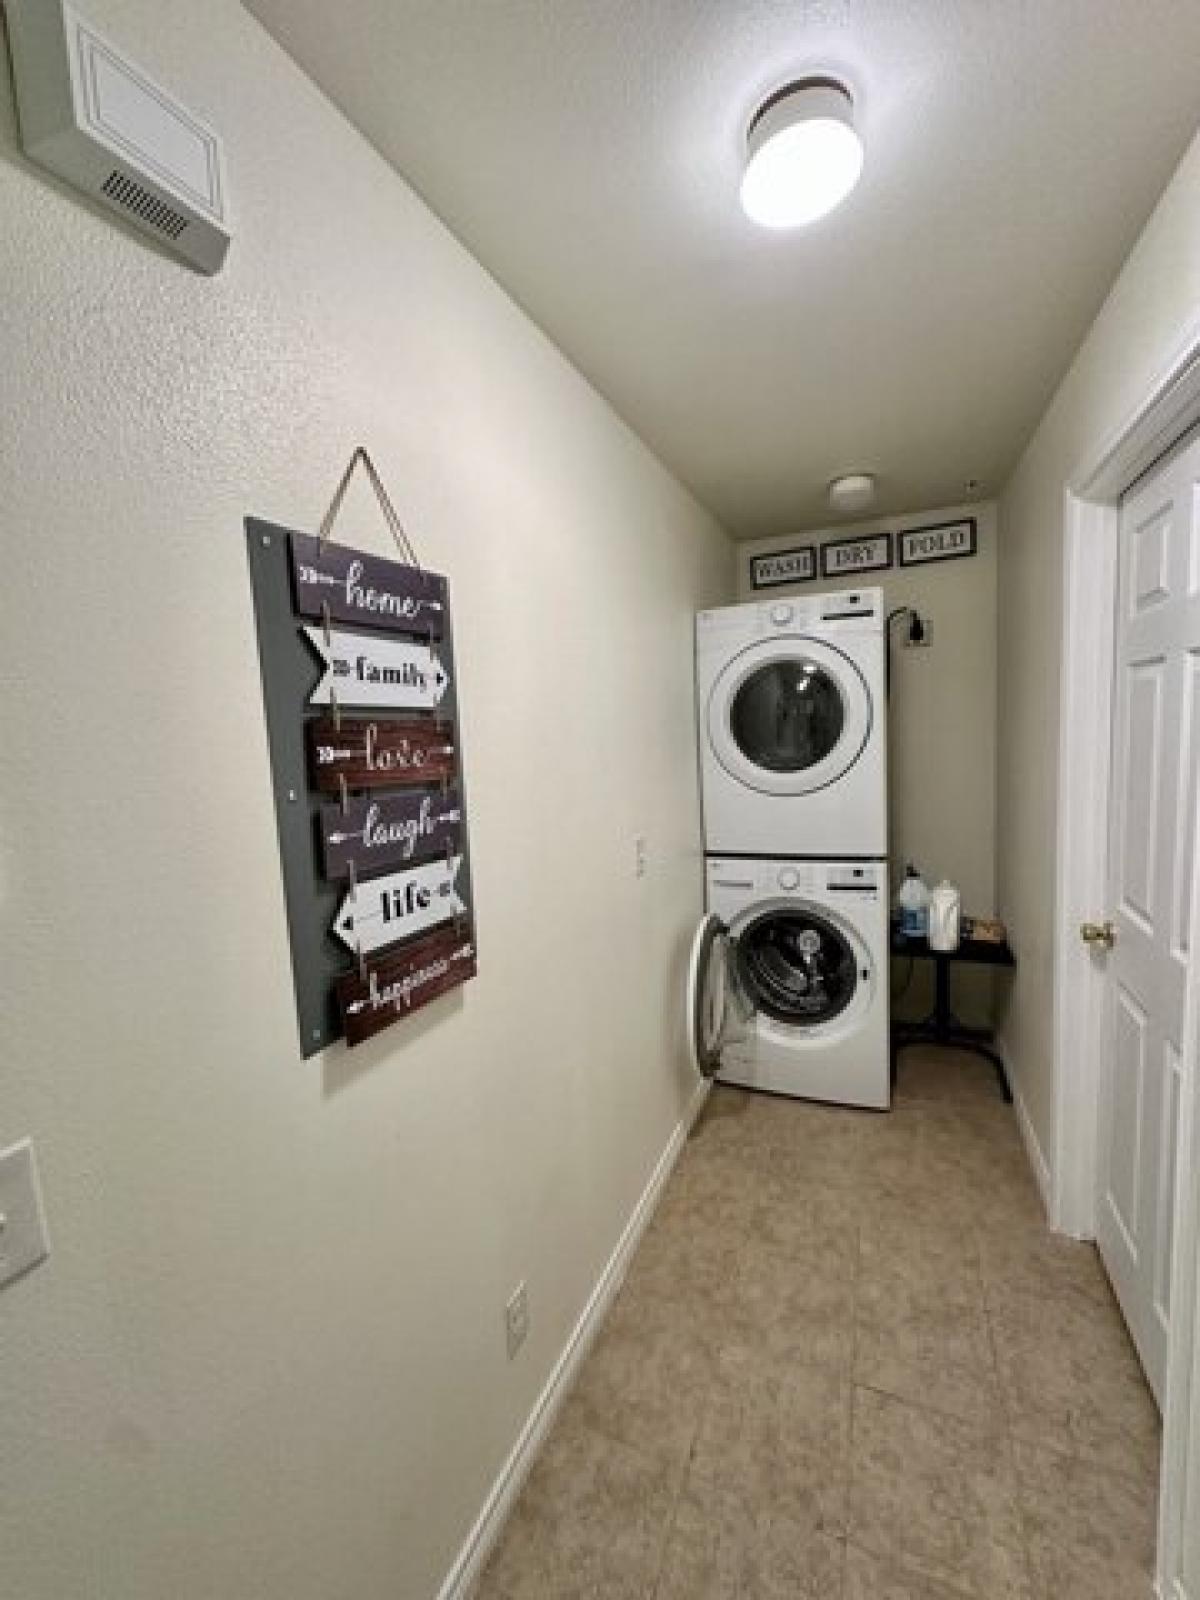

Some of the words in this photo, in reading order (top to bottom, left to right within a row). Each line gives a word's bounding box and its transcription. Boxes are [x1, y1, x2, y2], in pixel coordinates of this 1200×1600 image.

[836, 544, 876, 566] DRY
[908, 532, 965, 557] FOLD
[757, 556, 809, 577] WASH
[346, 560, 420, 618] home
[356, 656, 427, 694] family
[365, 722, 426, 770] love
[363, 796, 434, 858] laugh
[380, 880, 431, 924] life
